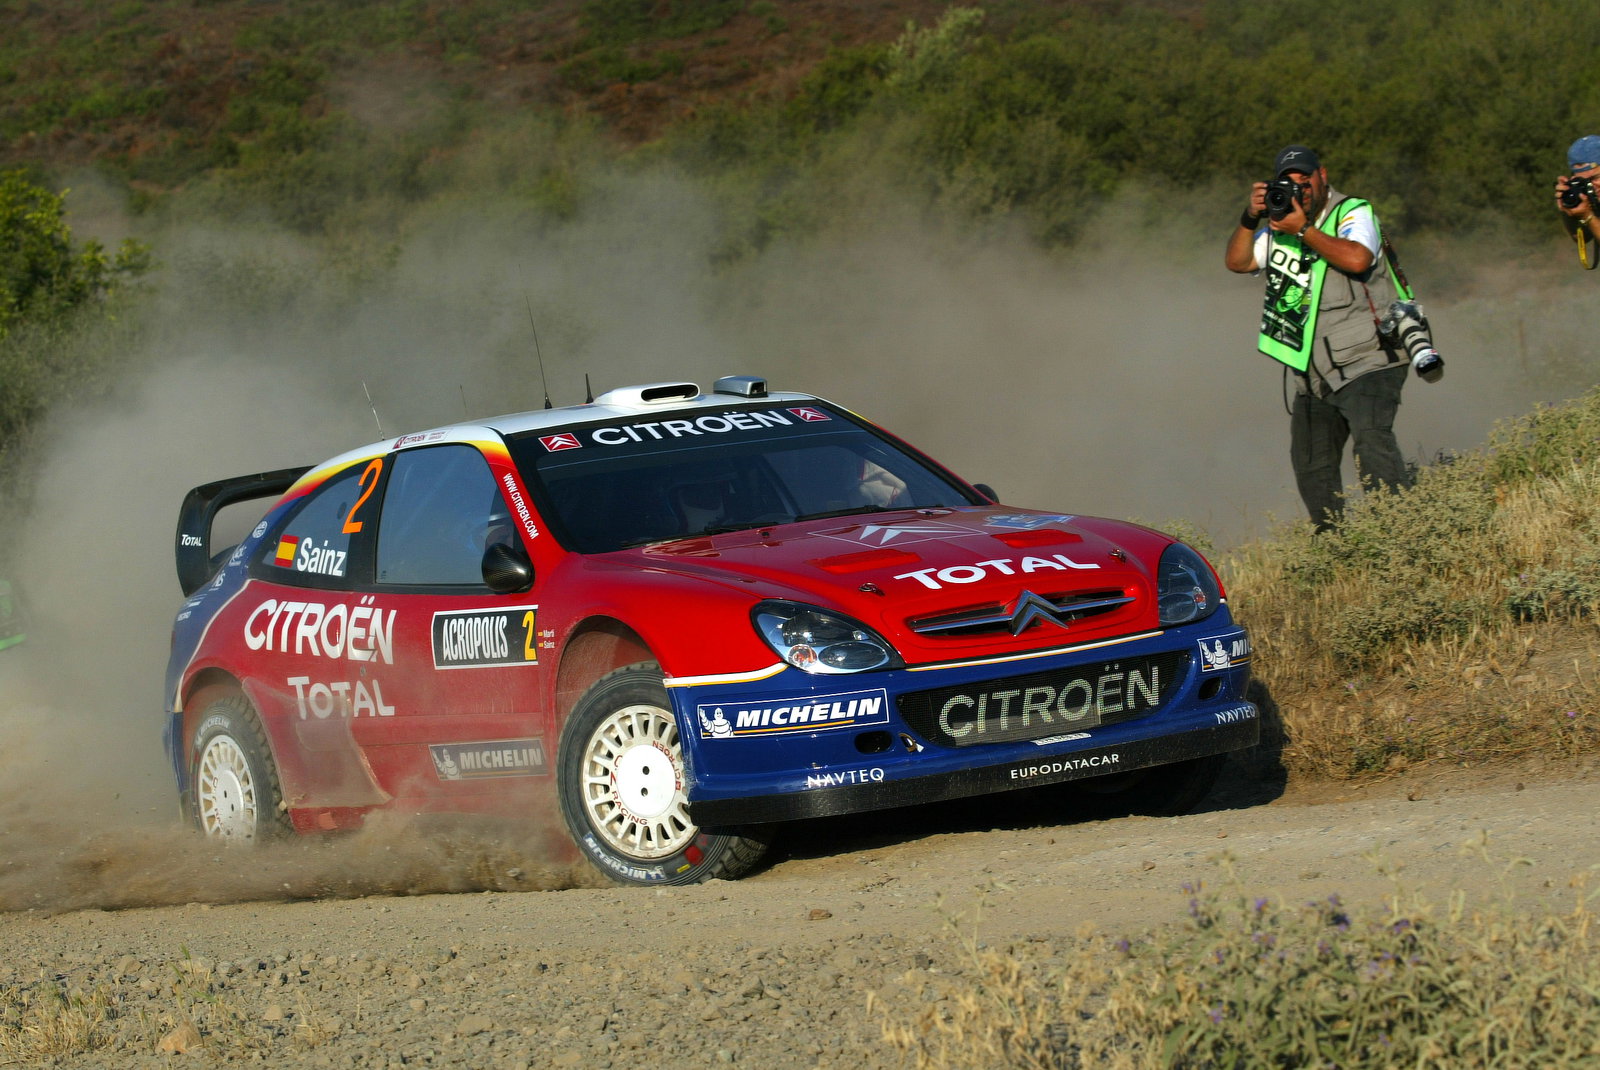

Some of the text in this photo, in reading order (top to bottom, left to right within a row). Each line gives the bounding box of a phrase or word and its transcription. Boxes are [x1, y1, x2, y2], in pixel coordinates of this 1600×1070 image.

[592, 411, 793, 445] CITROËN
[342, 458, 383, 534] 2
[503, 472, 539, 540] WWW.CITROEN.COM
[181, 534, 203, 547] TOTAL
[297, 537, 346, 577] Sainz
[895, 554, 1101, 590] TOTAL
[244, 594, 397, 665] CITROËN
[442, 610, 537, 661] ACROPOLIS 2
[287, 676, 395, 720] TOTAL
[736, 697, 882, 728] MICHELIN
[938, 663, 1159, 737] CITROËN
[1214, 705, 1256, 725] NAVTEQ
[460, 750, 543, 769] MICHELIN
[1010, 753, 1120, 780] EURODATACAR
[806, 767, 885, 789] NAVTEQ
[612, 790, 648, 826] RACING
[585, 832, 647, 880] MICHELIN
